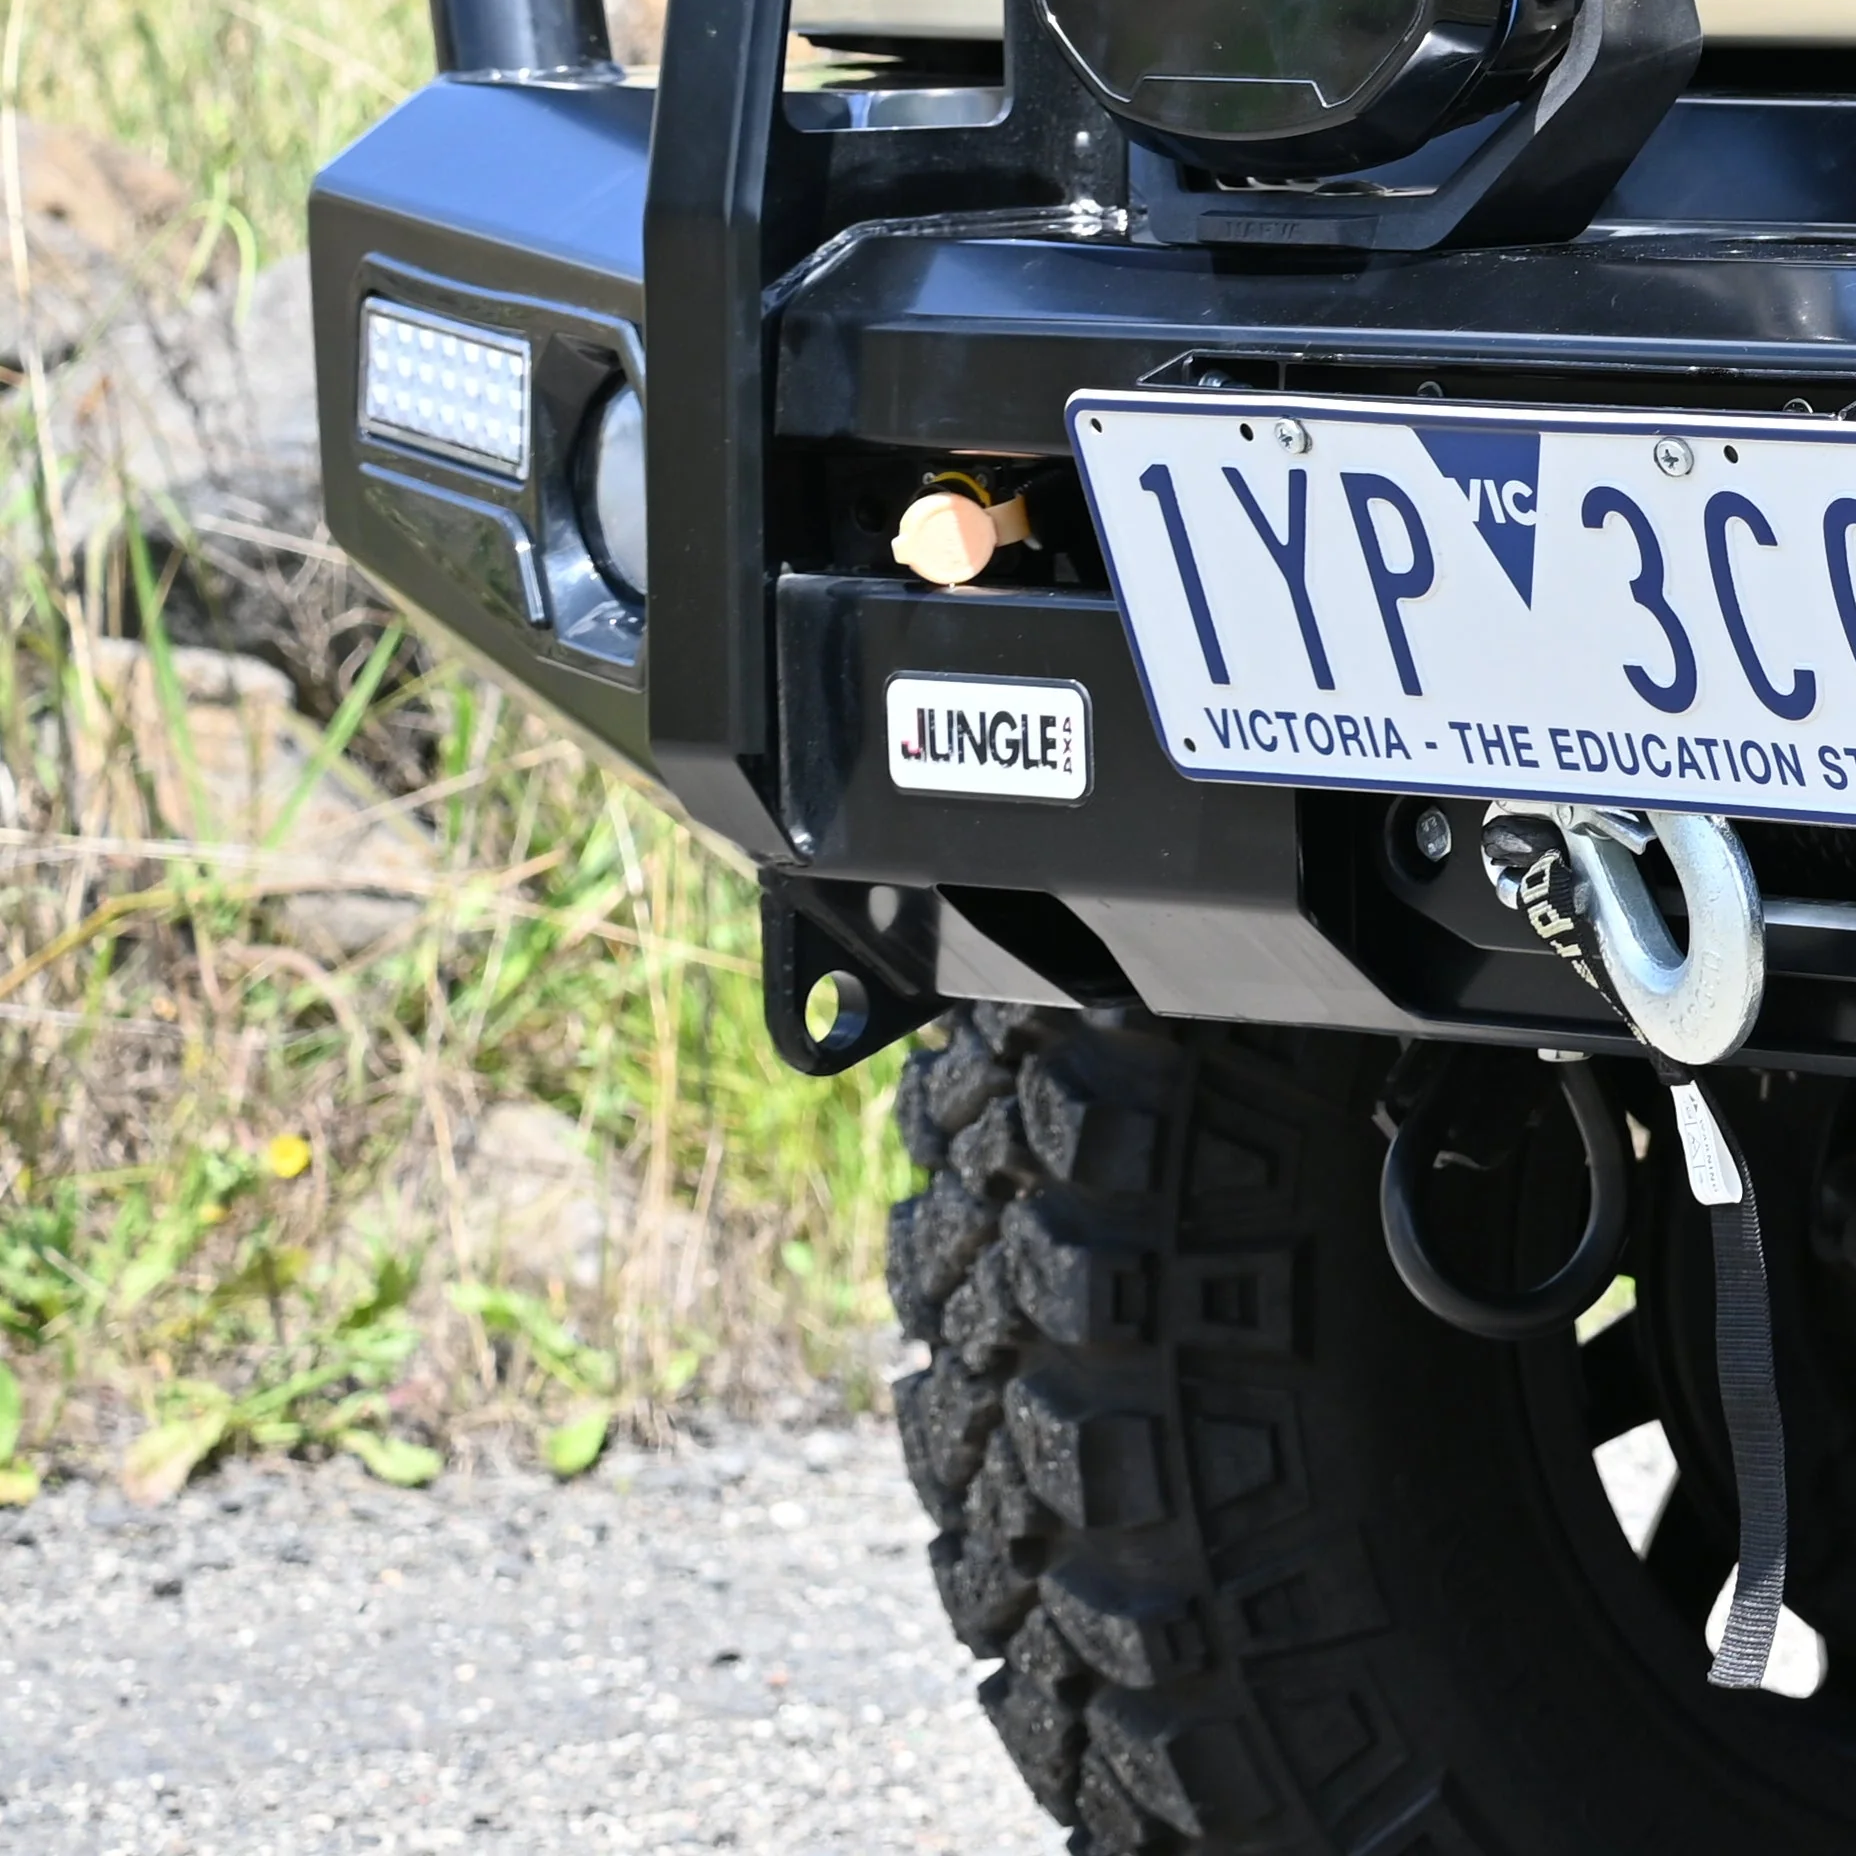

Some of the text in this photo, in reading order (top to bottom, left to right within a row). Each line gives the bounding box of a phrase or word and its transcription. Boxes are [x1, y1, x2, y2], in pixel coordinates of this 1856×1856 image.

[1444, 476, 1537, 527] VIC
[1139, 463, 1436, 697] 1YP
[900, 707, 1058, 771] JUNGLE
[1203, 706, 1413, 760] VICTORIA
[1448, 721, 1540, 769] THE
[1547, 727, 1807, 787] EDUCATION
